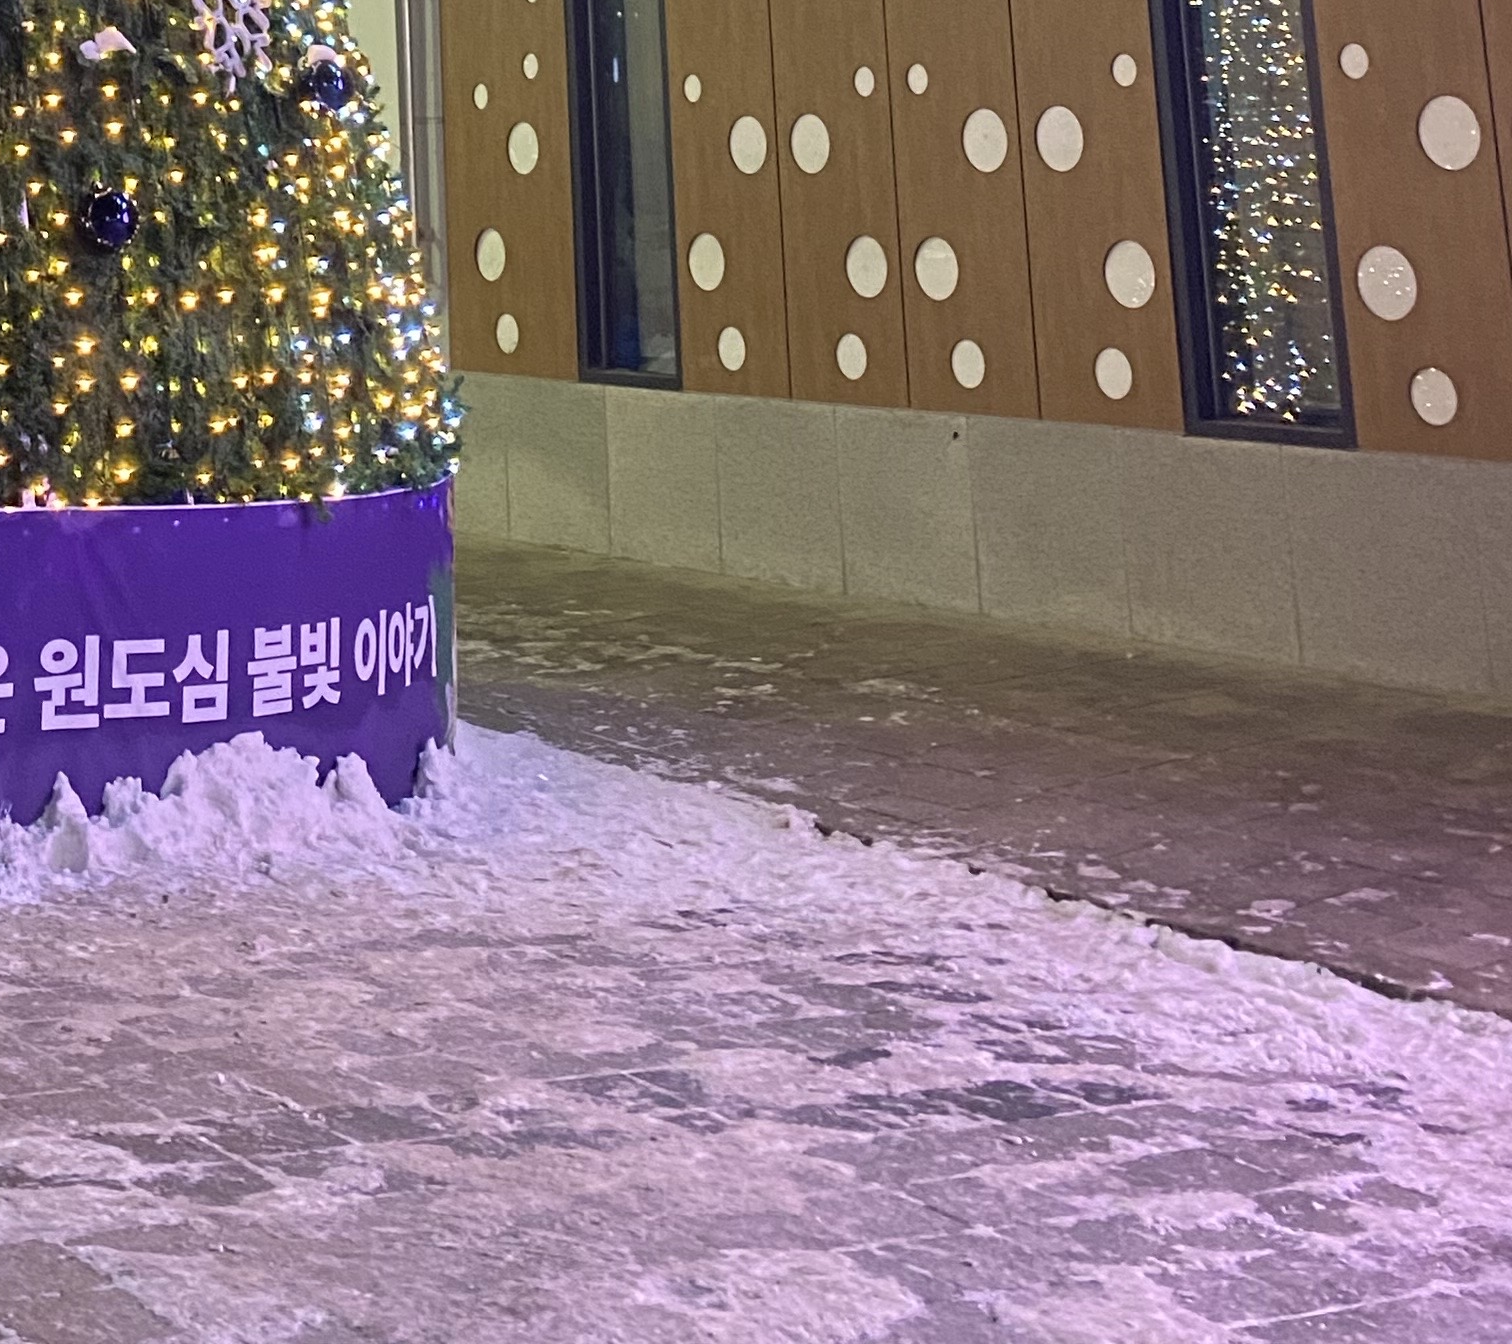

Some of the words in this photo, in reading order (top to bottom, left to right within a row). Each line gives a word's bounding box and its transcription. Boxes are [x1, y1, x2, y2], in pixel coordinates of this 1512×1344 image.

[33, 628, 231, 731] 원도심
[246, 616, 342, 718] 불빛
[354, 595, 439, 695] 이야기
